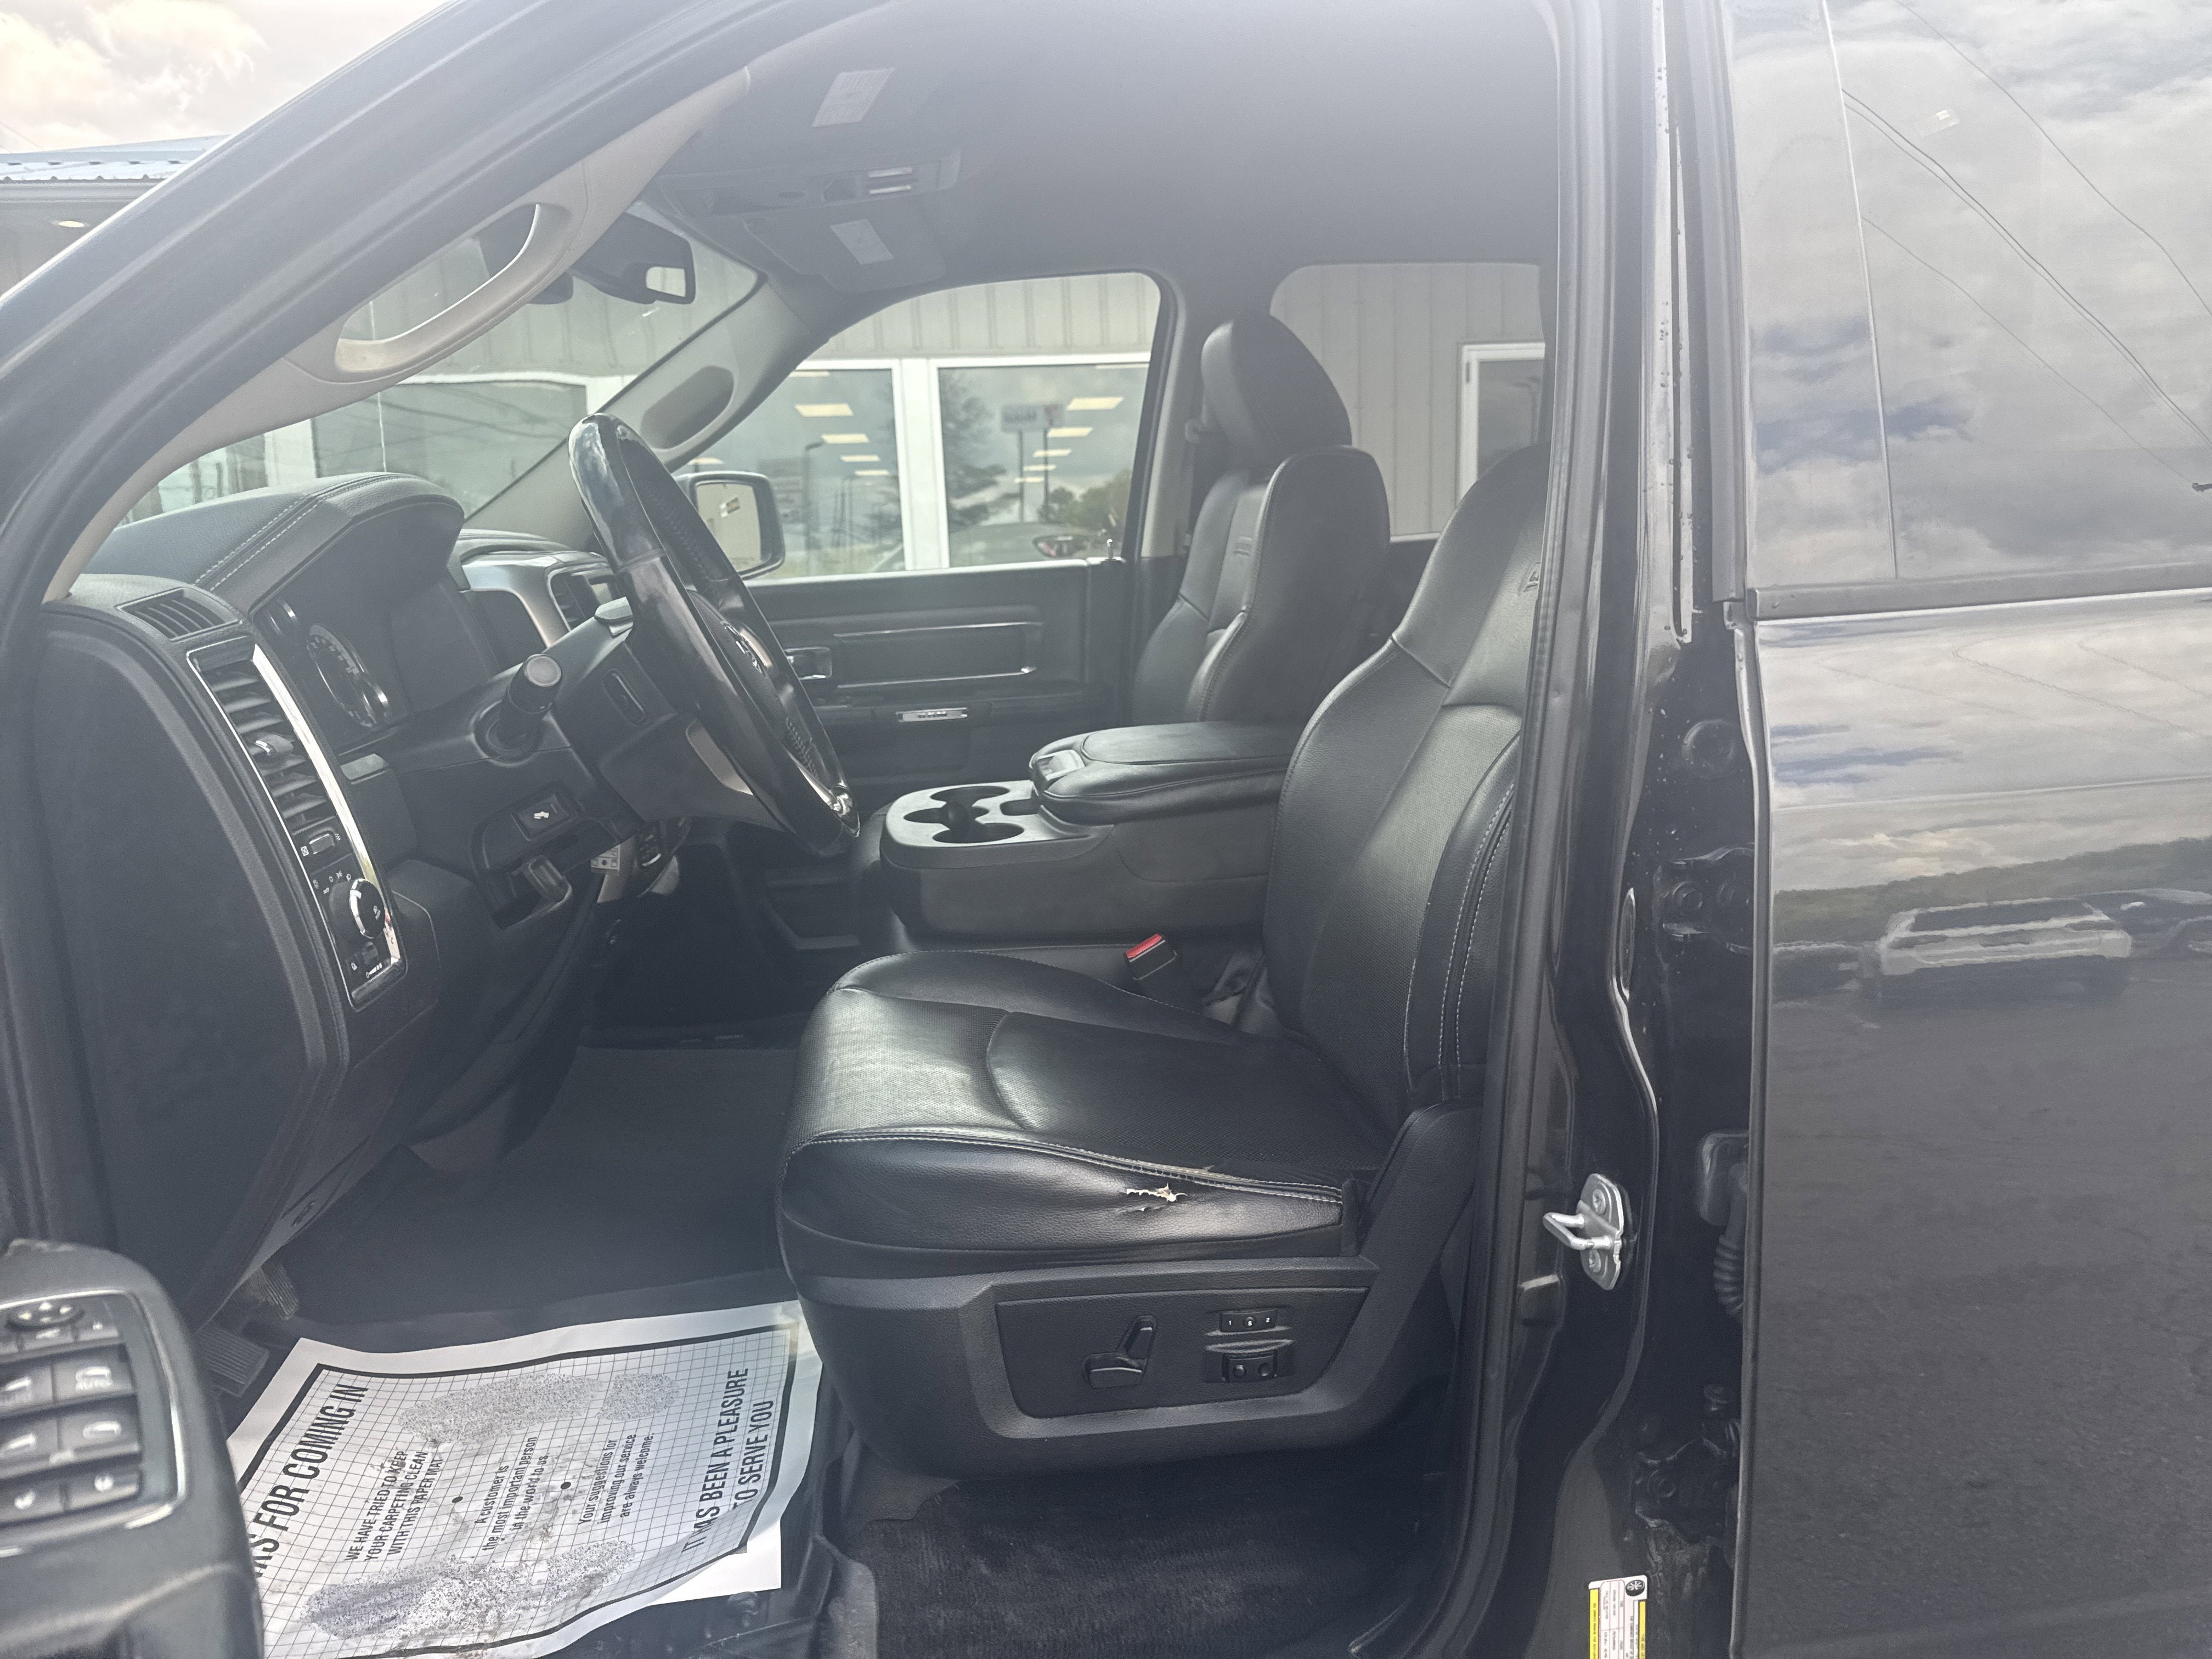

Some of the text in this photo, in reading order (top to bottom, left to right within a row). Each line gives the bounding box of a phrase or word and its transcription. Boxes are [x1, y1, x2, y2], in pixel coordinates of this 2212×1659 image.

[713, 1368, 749, 1446] PLEASURE
[748, 1400, 774, 1434] YOU
[252, 1485, 310, 1532] FOR
[282, 1406, 356, 1480] COMING
[329, 1384, 369, 1402] IN
[531, 1467, 544, 1476] to
[620, 1432, 654, 1518] are always welcome.
[710, 1447, 733, 1457] A
[738, 1434, 768, 1485] SERVE
[481, 1475, 505, 1516] customer
[495, 1465, 509, 1474] is
[482, 1436, 537, 1551] the most important person
[523, 1477, 540, 1504] world
[578, 1440, 617, 1525] Your suggestions for
[597, 1434, 636, 1524] improving our service
[699, 1462, 731, 1502] BEEN
[344, 1451, 408, 1561] WE HAVE TRIED TO KEEP
[364, 1451, 428, 1562] YOUR CARPETING CLEAN
[387, 1458, 443, 1555] WITH THIS PAPER MAT
[509, 1521, 525, 1531] in
[515, 1505, 531, 1520] the
[681, 1536, 707, 1553] IT
